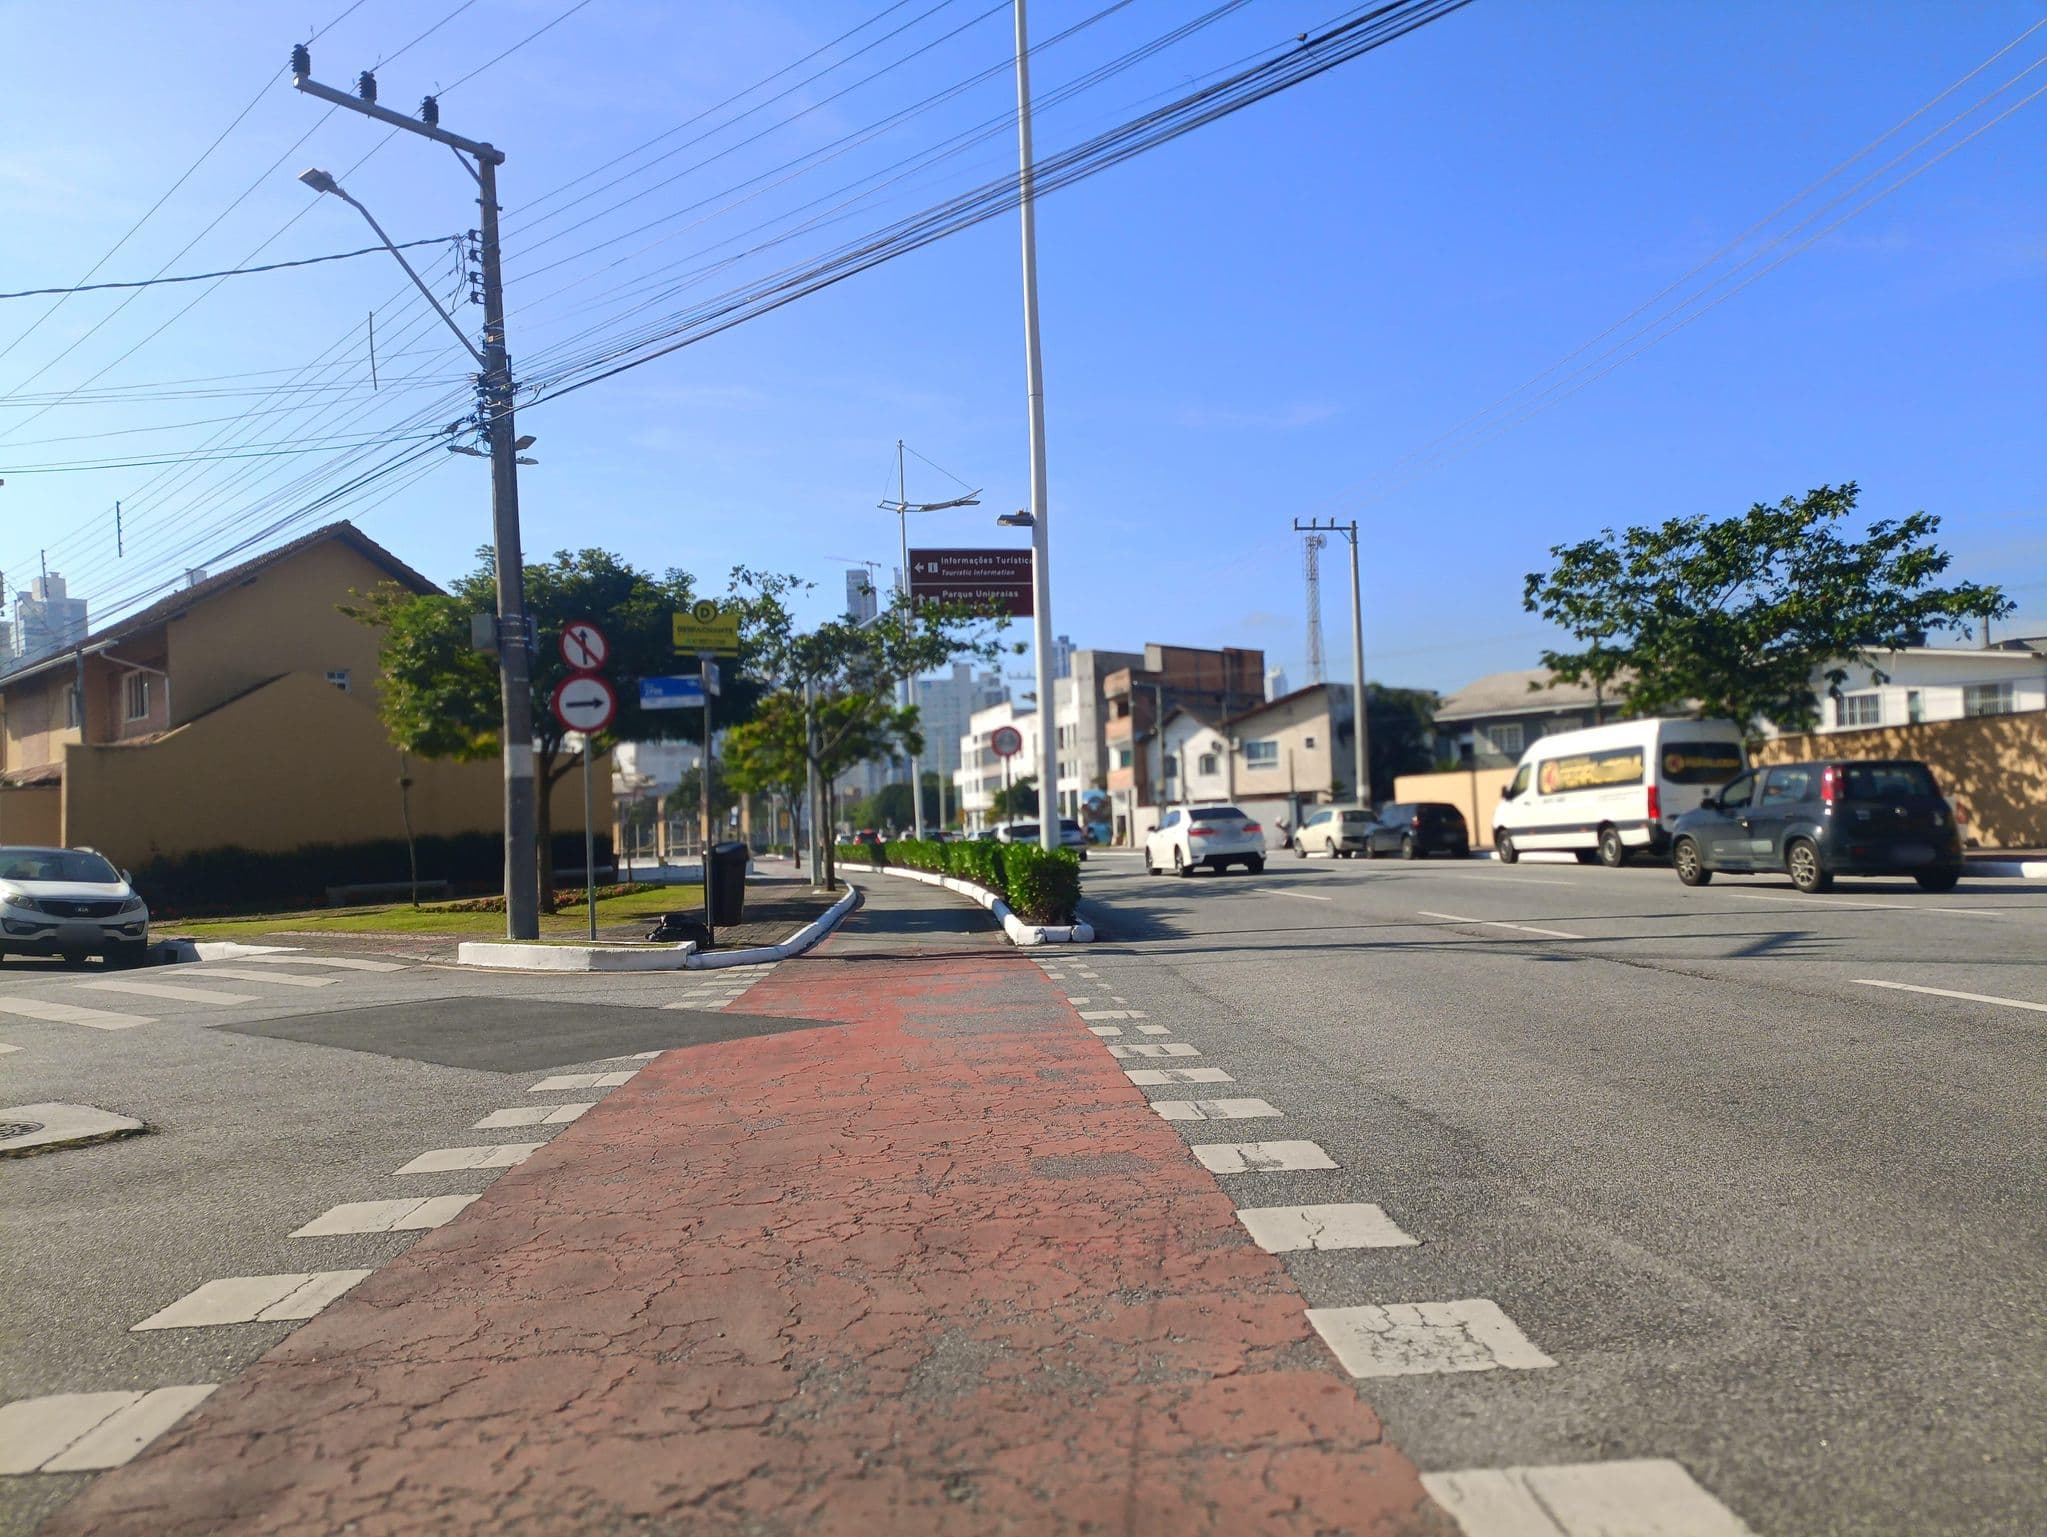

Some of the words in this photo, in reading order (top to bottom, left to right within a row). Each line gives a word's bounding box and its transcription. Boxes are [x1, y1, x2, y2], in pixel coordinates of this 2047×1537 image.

[941, 556, 993, 566] Informações
[942, 591, 973, 599] Parque
[700, 608, 710, 618] D
